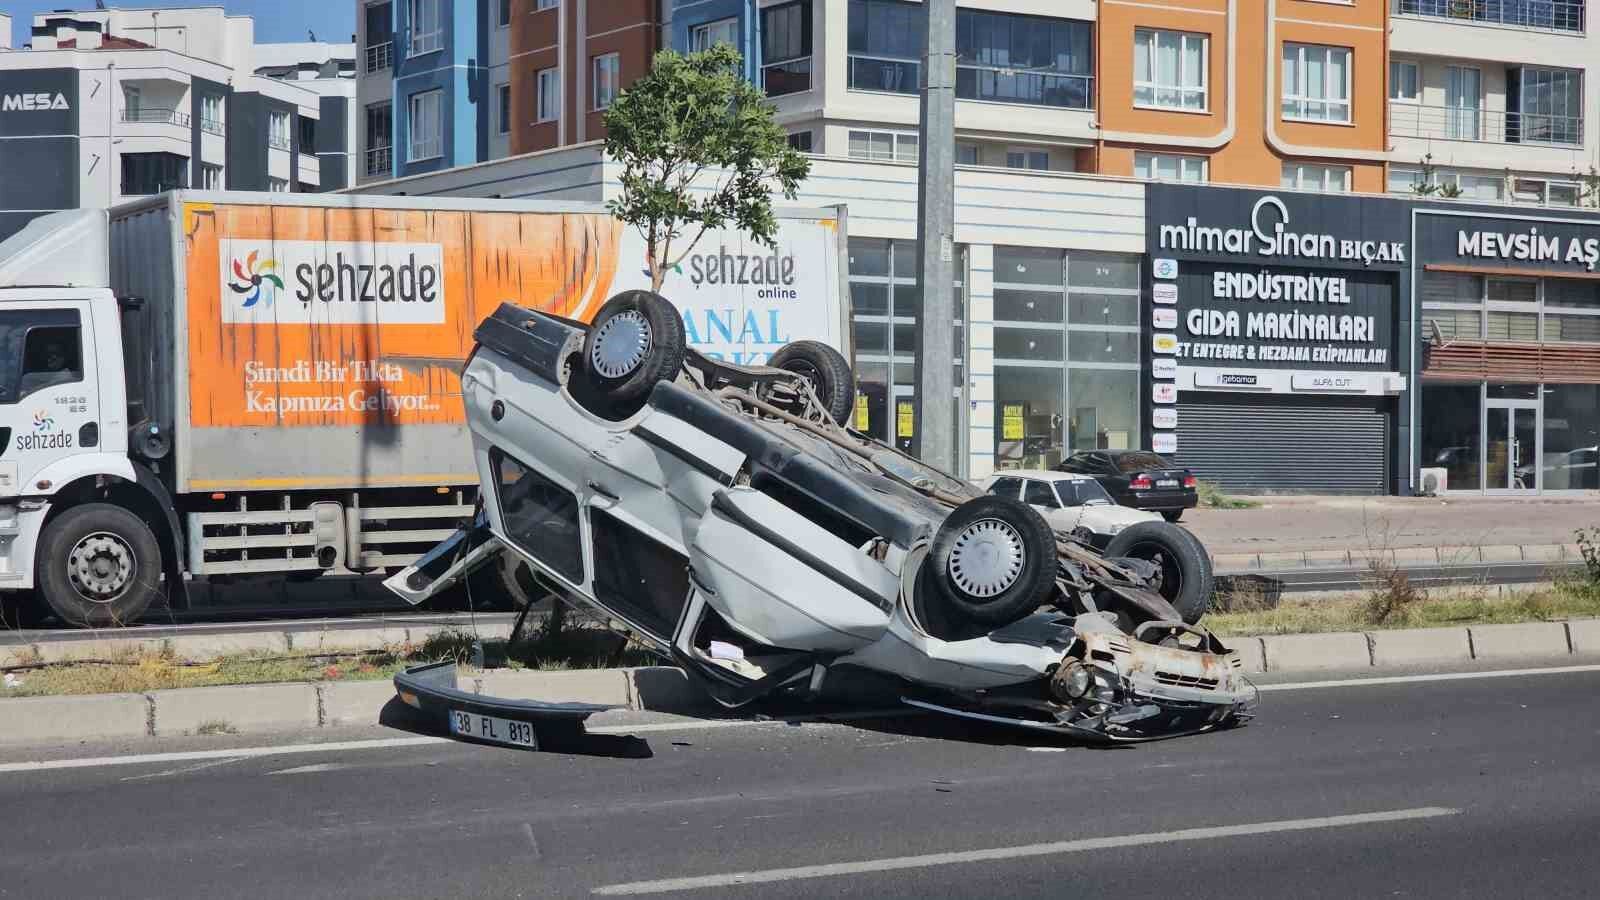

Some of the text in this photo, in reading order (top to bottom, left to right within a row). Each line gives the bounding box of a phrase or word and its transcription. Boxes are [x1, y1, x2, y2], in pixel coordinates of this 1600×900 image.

[2, 93, 70, 111] MESA
[1340, 239, 1406, 266] BIÇAK
[1457, 226, 1560, 261] MEVSİM
[295, 251, 437, 310] şehzade
[690, 245, 795, 290] şehzade
[757, 287, 797, 300] online
[1213, 269, 1351, 304] ENDÜSTRİYEL
[1186, 308, 1375, 342] GIDA MAKİNALARI
[1192, 343, 1245, 360] ENTEGRE
[1246, 345, 1257, 361] &
[315, 360, 347, 382] Bir
[244, 390, 345, 419] Kapınıza
[457, 712, 531, 743] 38 FL 813
